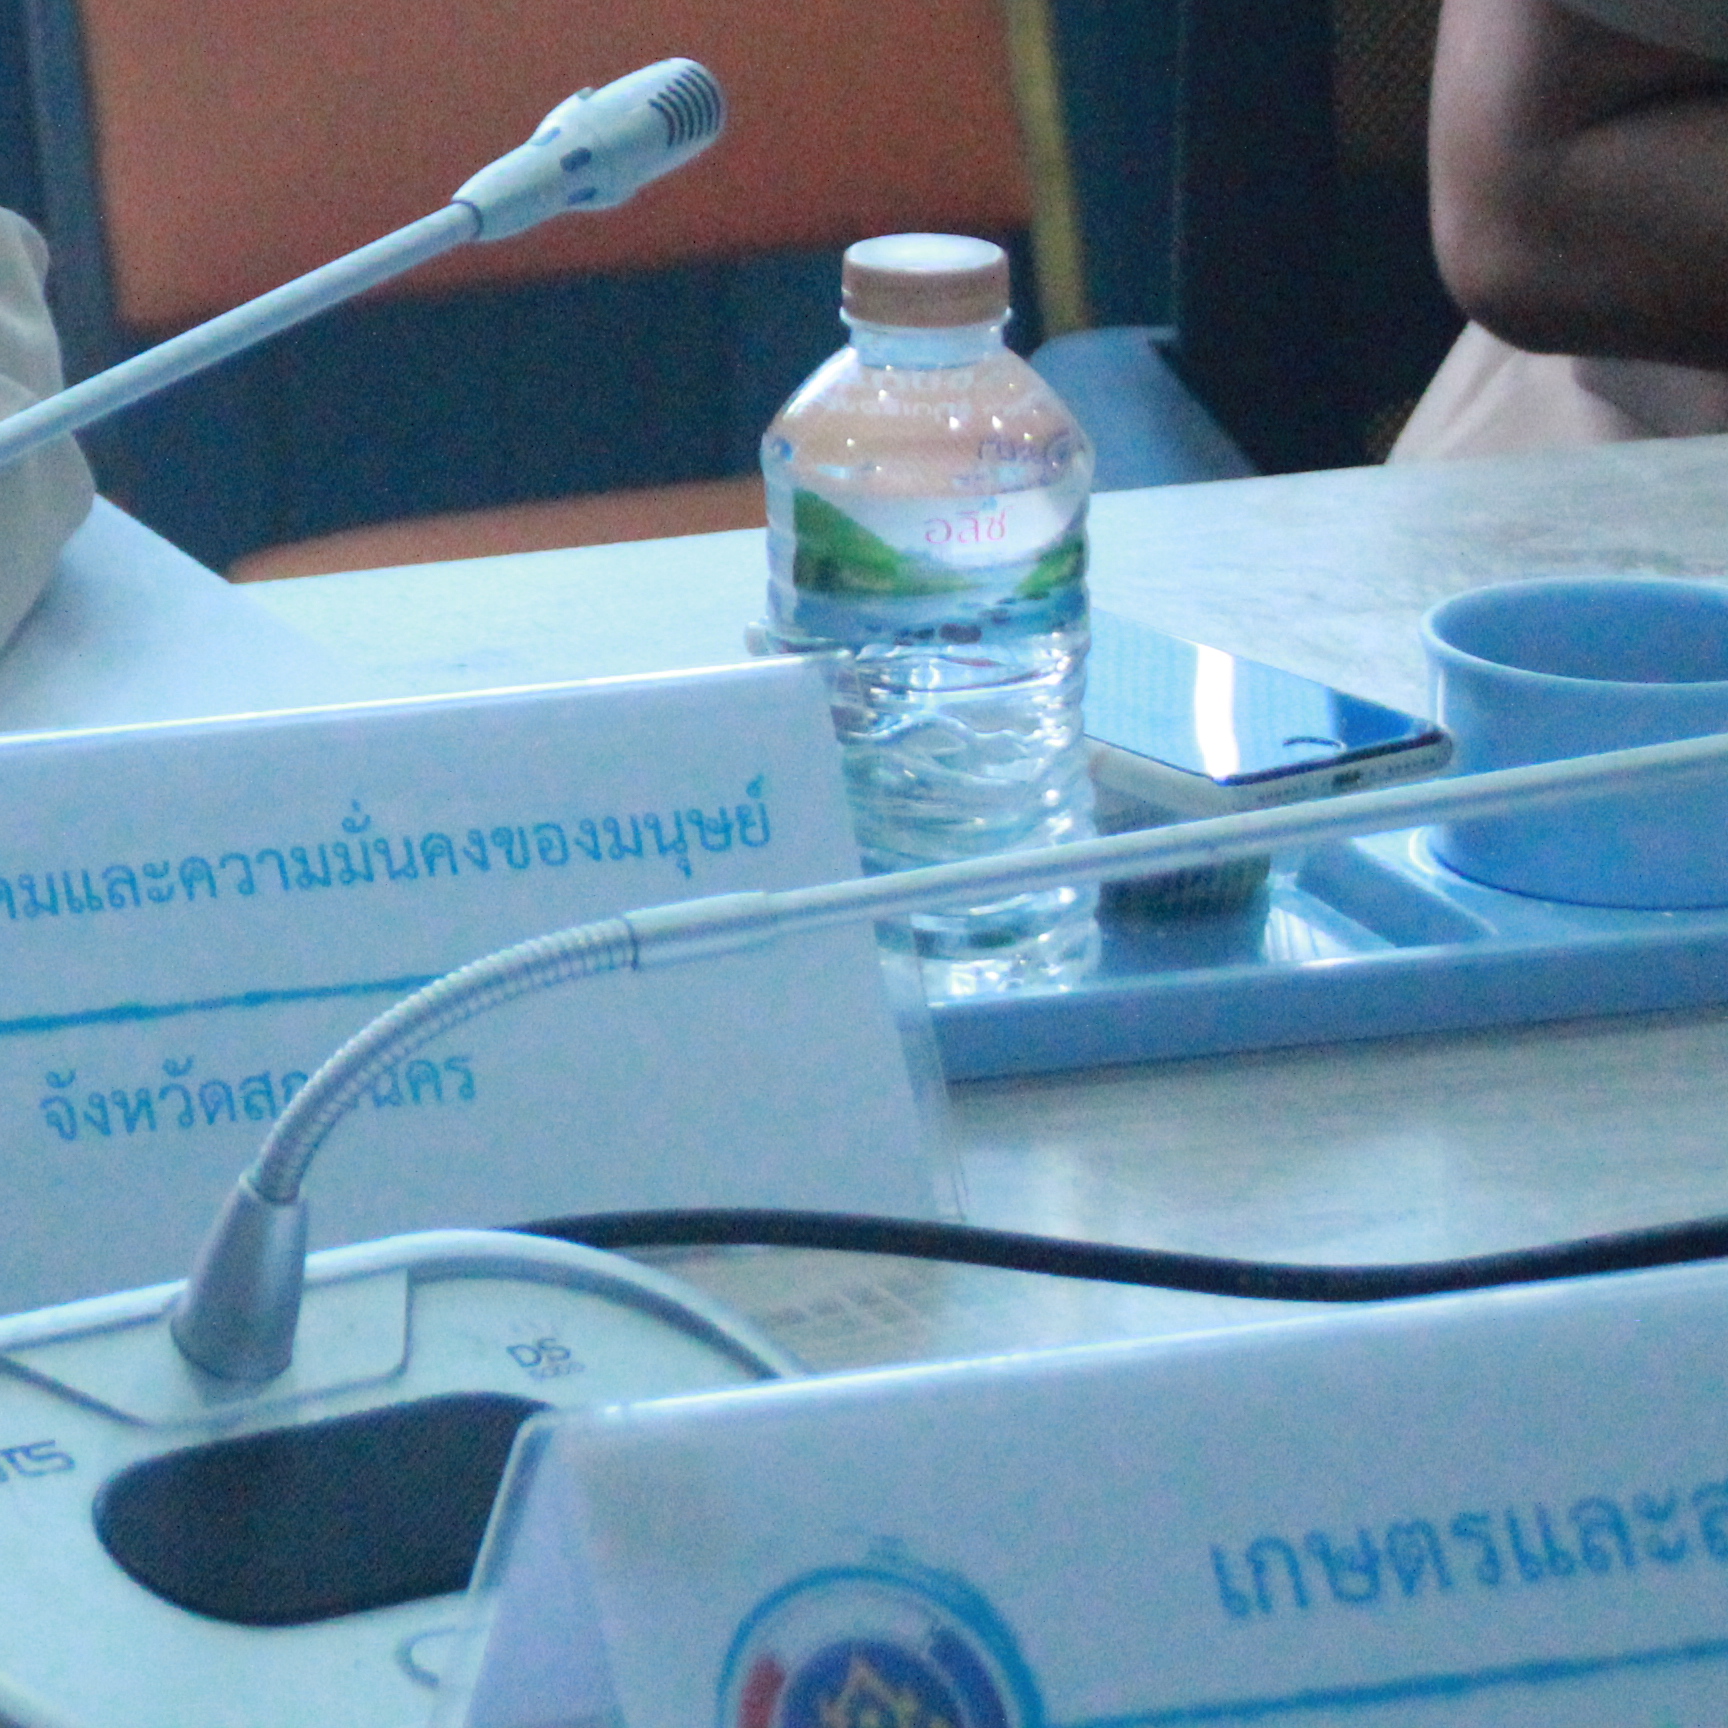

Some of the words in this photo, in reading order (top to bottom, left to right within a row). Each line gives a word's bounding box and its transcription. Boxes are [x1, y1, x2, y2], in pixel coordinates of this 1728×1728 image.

[40, 1052, 477, 1142] จังหวัดสกนคร
